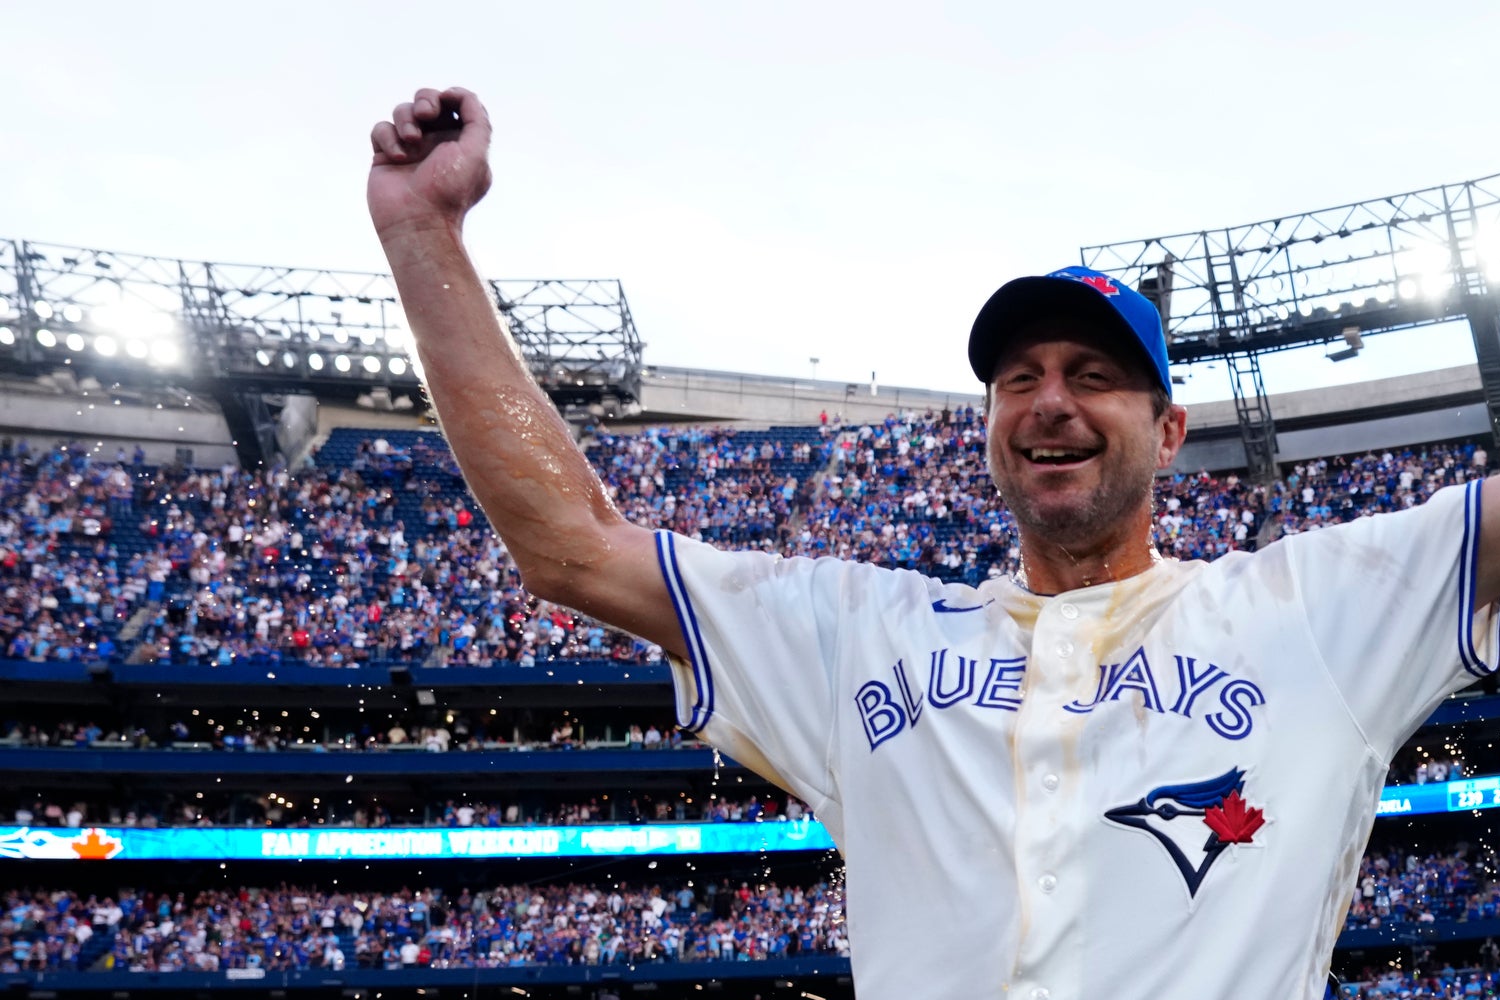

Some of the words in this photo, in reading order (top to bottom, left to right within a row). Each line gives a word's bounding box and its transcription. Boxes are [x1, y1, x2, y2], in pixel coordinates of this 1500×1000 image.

[854, 649, 1028, 753] BLUE
[1062, 645, 1266, 741] JAYS
[261, 832, 309, 856] FAN
[315, 831, 442, 855] APPRECIATION
[448, 829, 559, 855] WEEKEND
